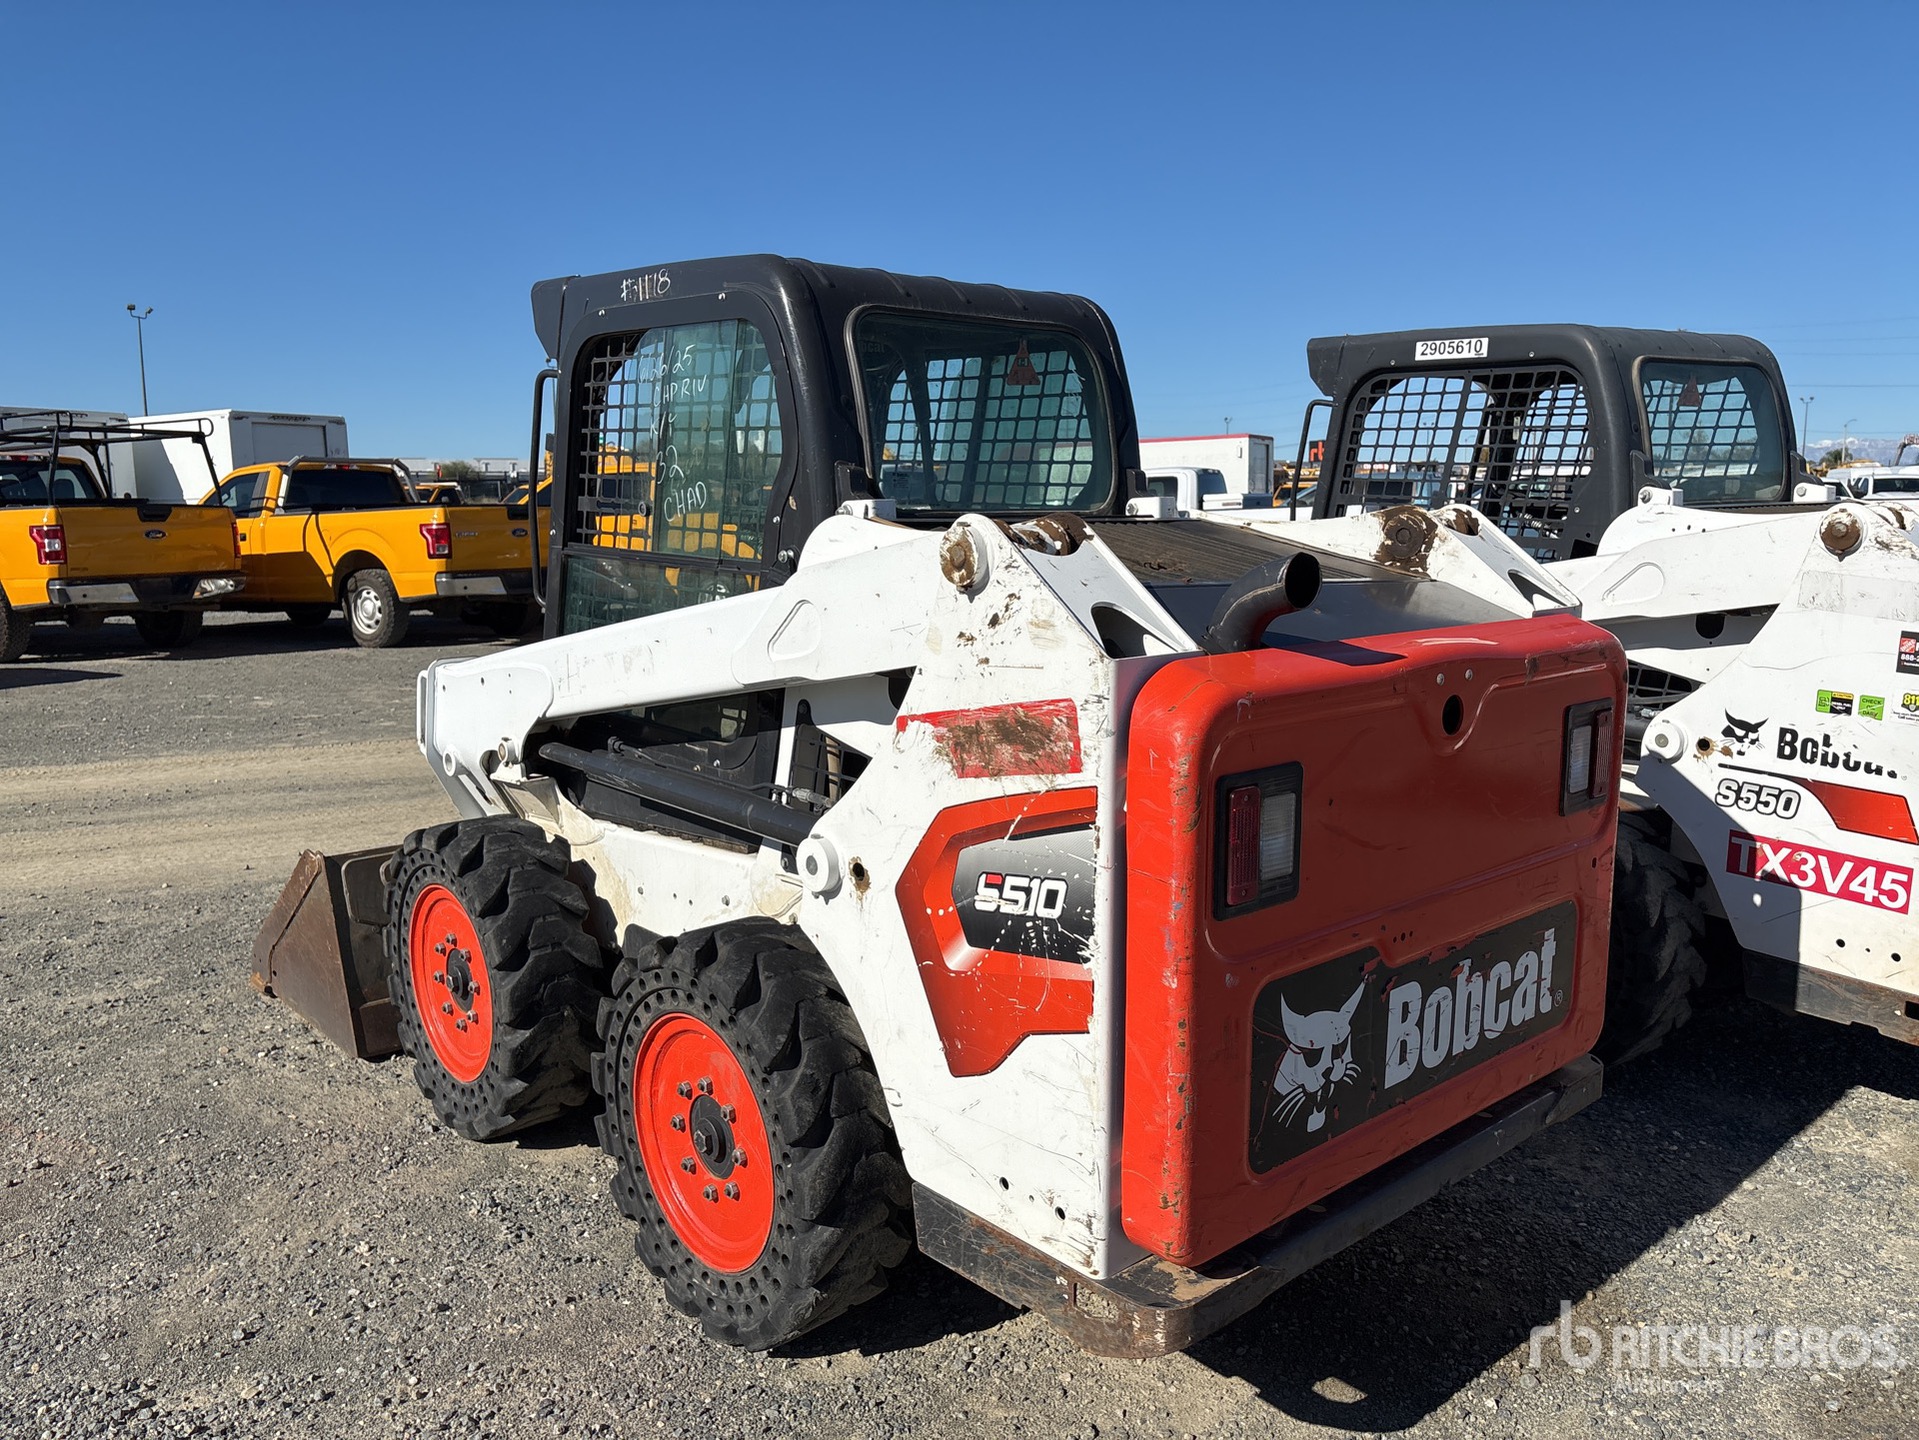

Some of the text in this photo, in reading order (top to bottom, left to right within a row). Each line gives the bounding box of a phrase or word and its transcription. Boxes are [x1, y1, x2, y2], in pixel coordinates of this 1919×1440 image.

[1420, 339, 1484, 356] 2905610
[656, 444, 685, 485] 32
[663, 481, 707, 522] CHAD
[1715, 778, 1801, 820] S550
[1731, 837, 1909, 909] TX3V45
[974, 872, 1068, 919] S510
[1385, 928, 1557, 1090] Bobcat
